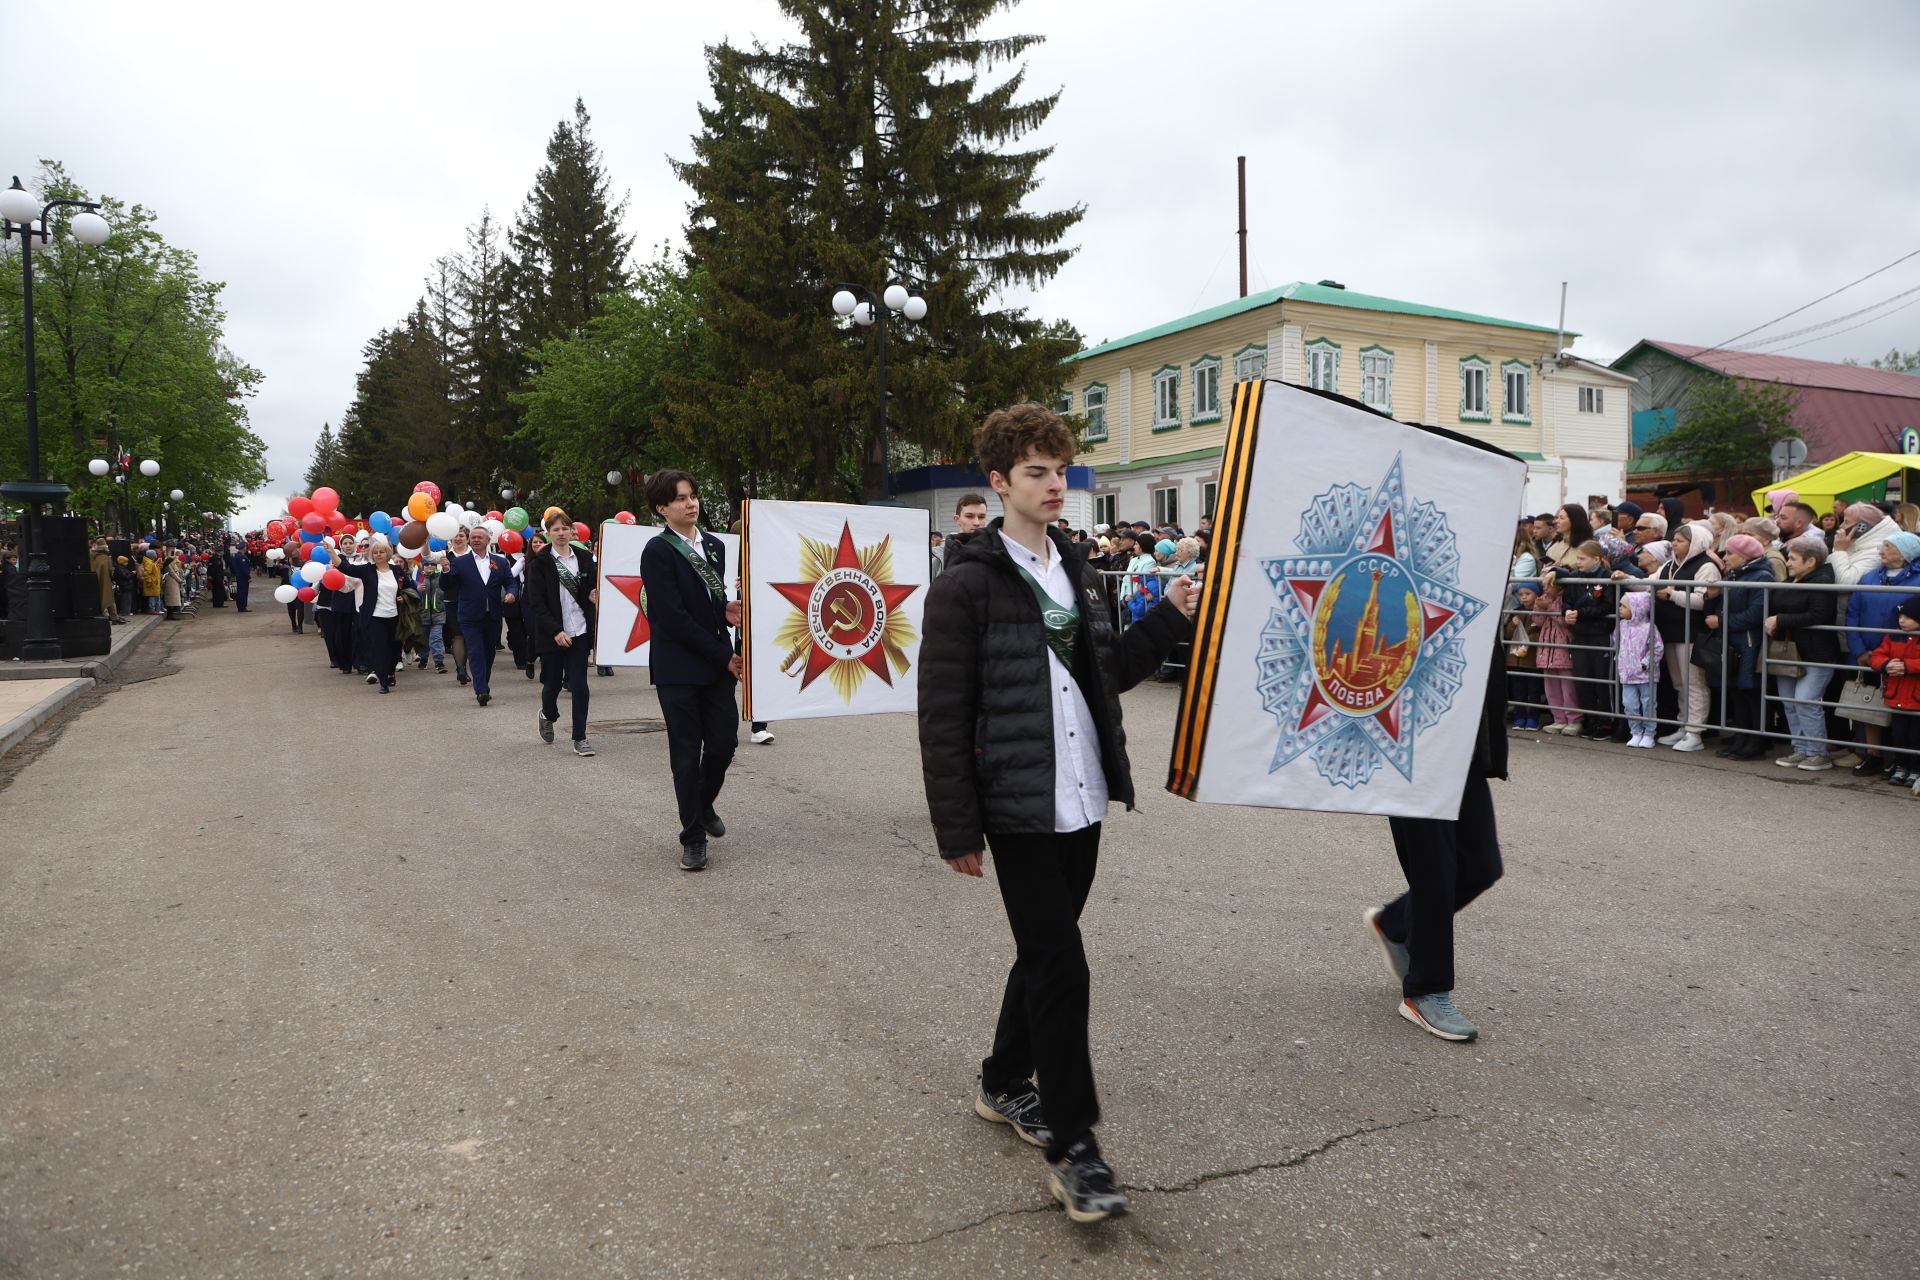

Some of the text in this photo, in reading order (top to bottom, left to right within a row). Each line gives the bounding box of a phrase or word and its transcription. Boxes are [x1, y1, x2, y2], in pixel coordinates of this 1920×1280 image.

[1358, 559, 1399, 578] СССР
[811, 571, 878, 651] ОТЕЧЕСТВЕННАЯ
[1328, 679, 1385, 706] ПОБЕДА
